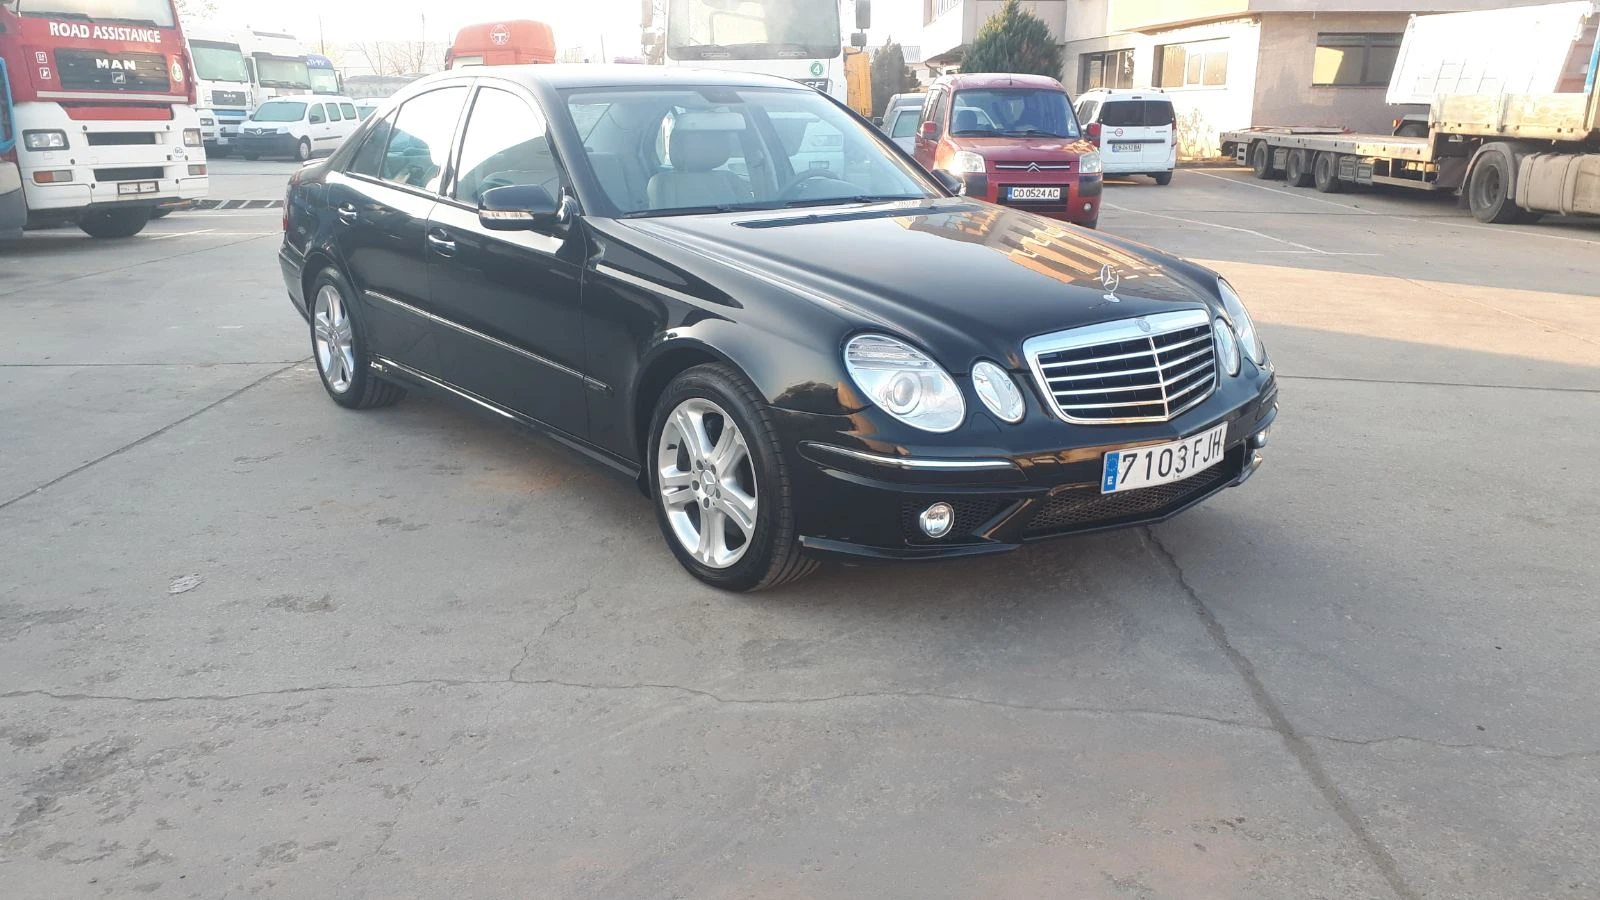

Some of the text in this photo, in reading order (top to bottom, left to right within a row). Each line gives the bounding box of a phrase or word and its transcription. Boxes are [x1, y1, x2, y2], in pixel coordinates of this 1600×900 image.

[49, 22, 161, 43] ROAD ASSISTANCE
[95, 58, 136, 71] MAN
[1013, 189, 1059, 198] CO 0524 AC
[1120, 428, 1223, 484] 7103 FJH
[1107, 475, 1113, 485] E
